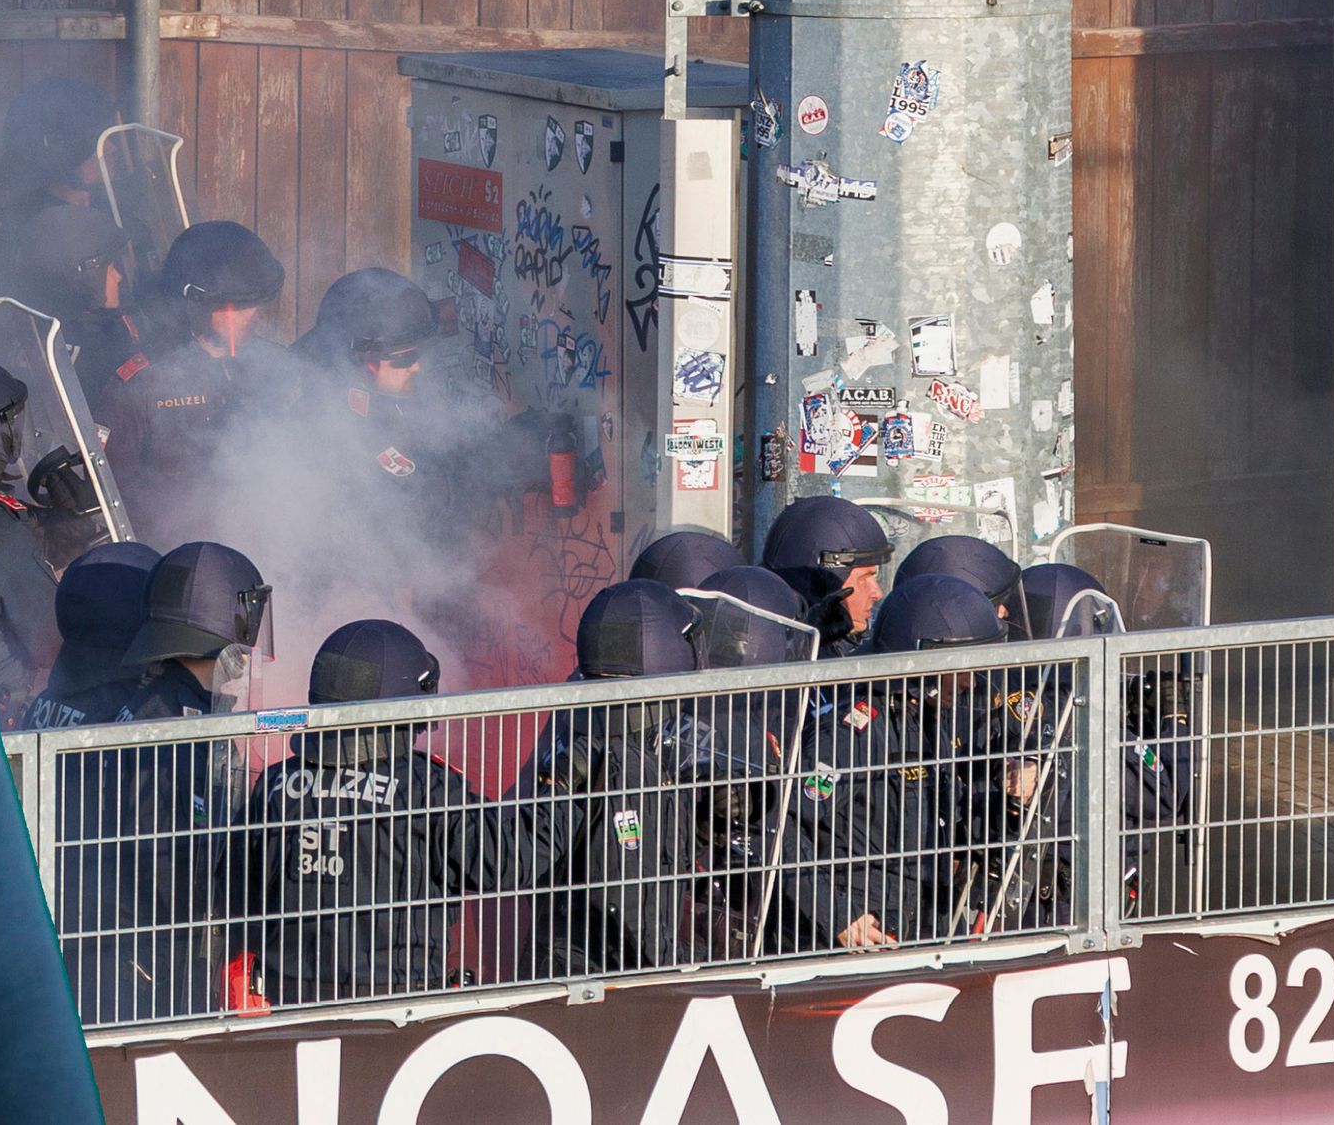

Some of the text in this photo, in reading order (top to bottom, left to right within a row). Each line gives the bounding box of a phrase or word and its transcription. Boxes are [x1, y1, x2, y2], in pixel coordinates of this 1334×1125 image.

[890, 97, 927, 116] 1995
[156, 395, 206, 409] POLIZEI
[842, 389, 892, 401] A.C.A.B.
[267, 768, 400, 806] POLIZEI
[299, 823, 348, 851] ST
[298, 855, 345, 877] 340
